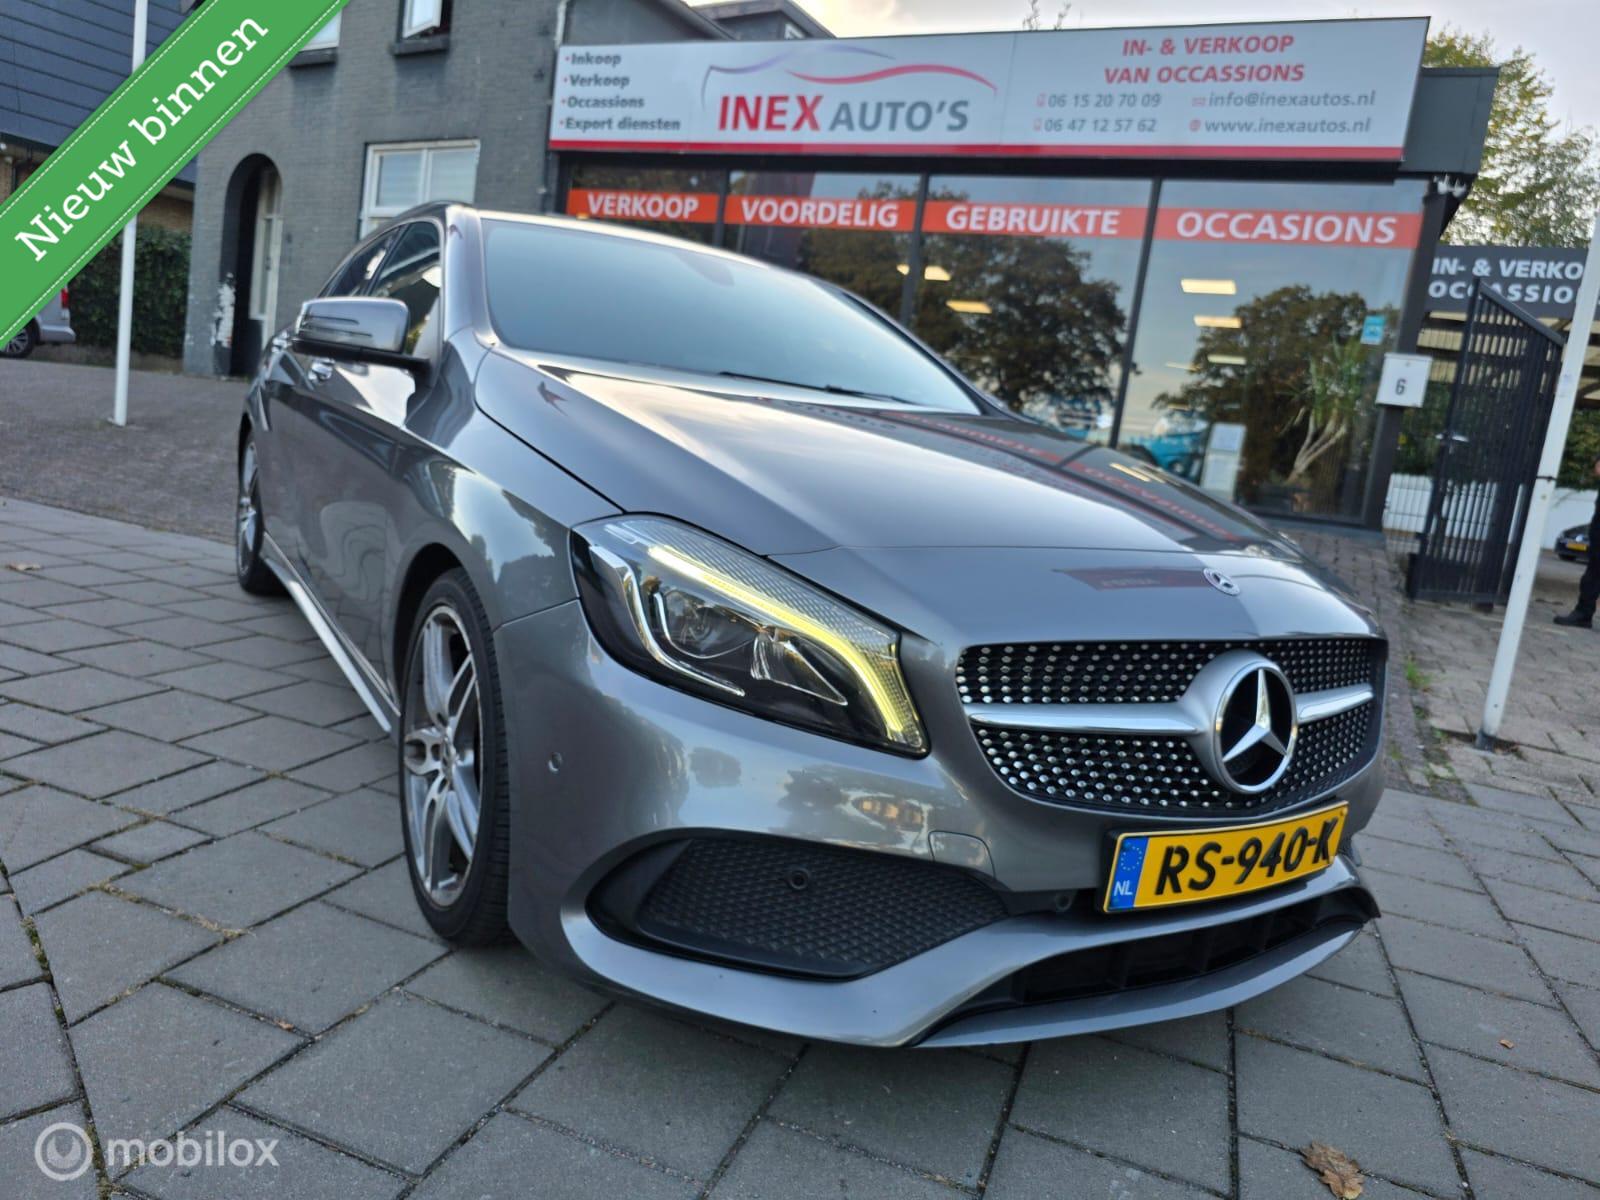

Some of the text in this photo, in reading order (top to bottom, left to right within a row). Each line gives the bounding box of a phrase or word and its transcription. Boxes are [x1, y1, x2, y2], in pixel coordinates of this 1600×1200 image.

[1122, 35, 1294, 56] IN- & VERKOOP
[570, 52, 622, 67] Inkoop
[569, 74, 630, 89] Verkoop
[1104, 64, 1305, 84] VAN OCCASSIONS
[567, 95, 645, 108] Occassions
[1048, 92, 1162, 108] 06 15 20 70 09
[1208, 90, 1376, 107] info@inexautos.nl
[718, 95, 969, 131] INEX AUTO'S
[565, 117, 681, 132] Export diensten
[1044, 118, 1157, 132] 06 47 12 57 62
[1205, 117, 1372, 133] www.inexautos.nl
[587, 193, 1397, 244] VERKOOP VOORDELIG GEBRUIKTE OCCASIONS
[1431, 257, 1584, 280] IN- & VERKO
[1395, 379, 1406, 395] 6
[1114, 816, 1338, 897] NL RS-940-K
